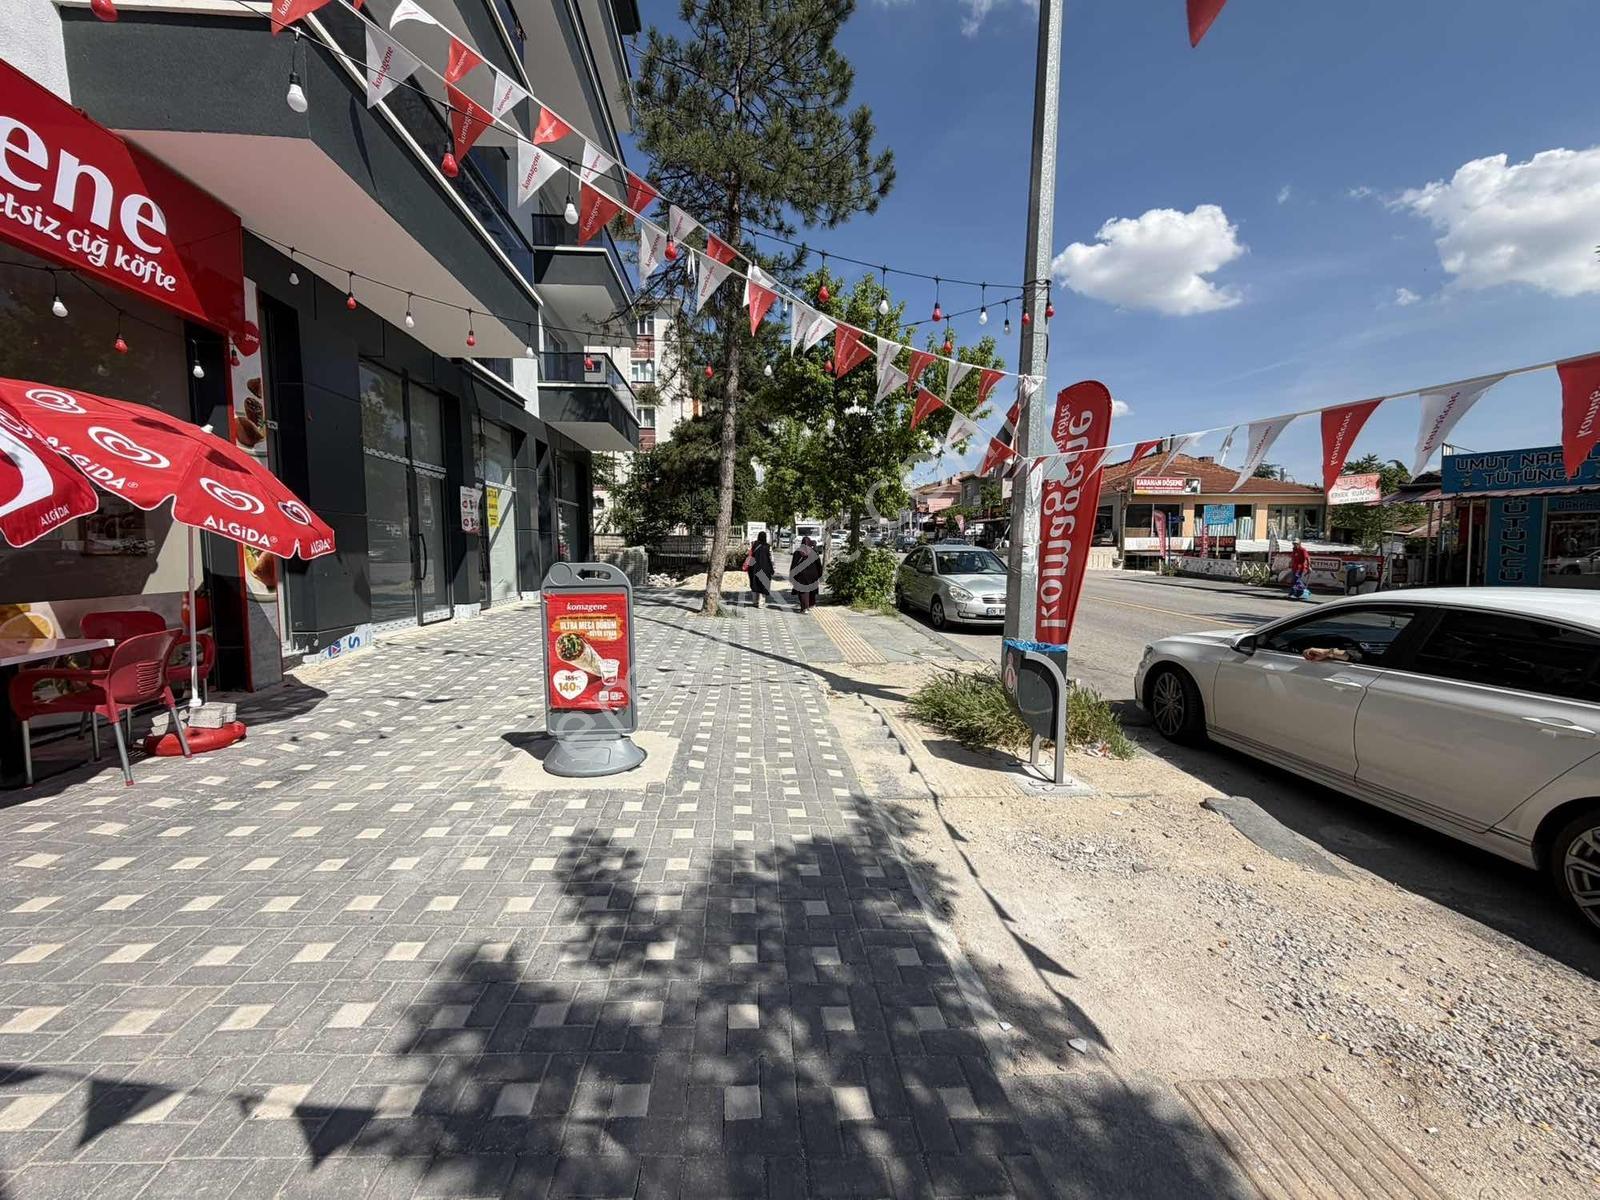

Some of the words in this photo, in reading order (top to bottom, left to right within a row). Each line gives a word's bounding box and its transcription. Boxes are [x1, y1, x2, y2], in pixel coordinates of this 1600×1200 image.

[520, 152, 542, 190] komagene
[66, 229, 109, 268] çiğ
[114, 245, 176, 292] köfte
[1456, 454, 1512, 471] UMUT
[566, 602, 608, 612] komagene
[559, 682, 576, 692] 140
